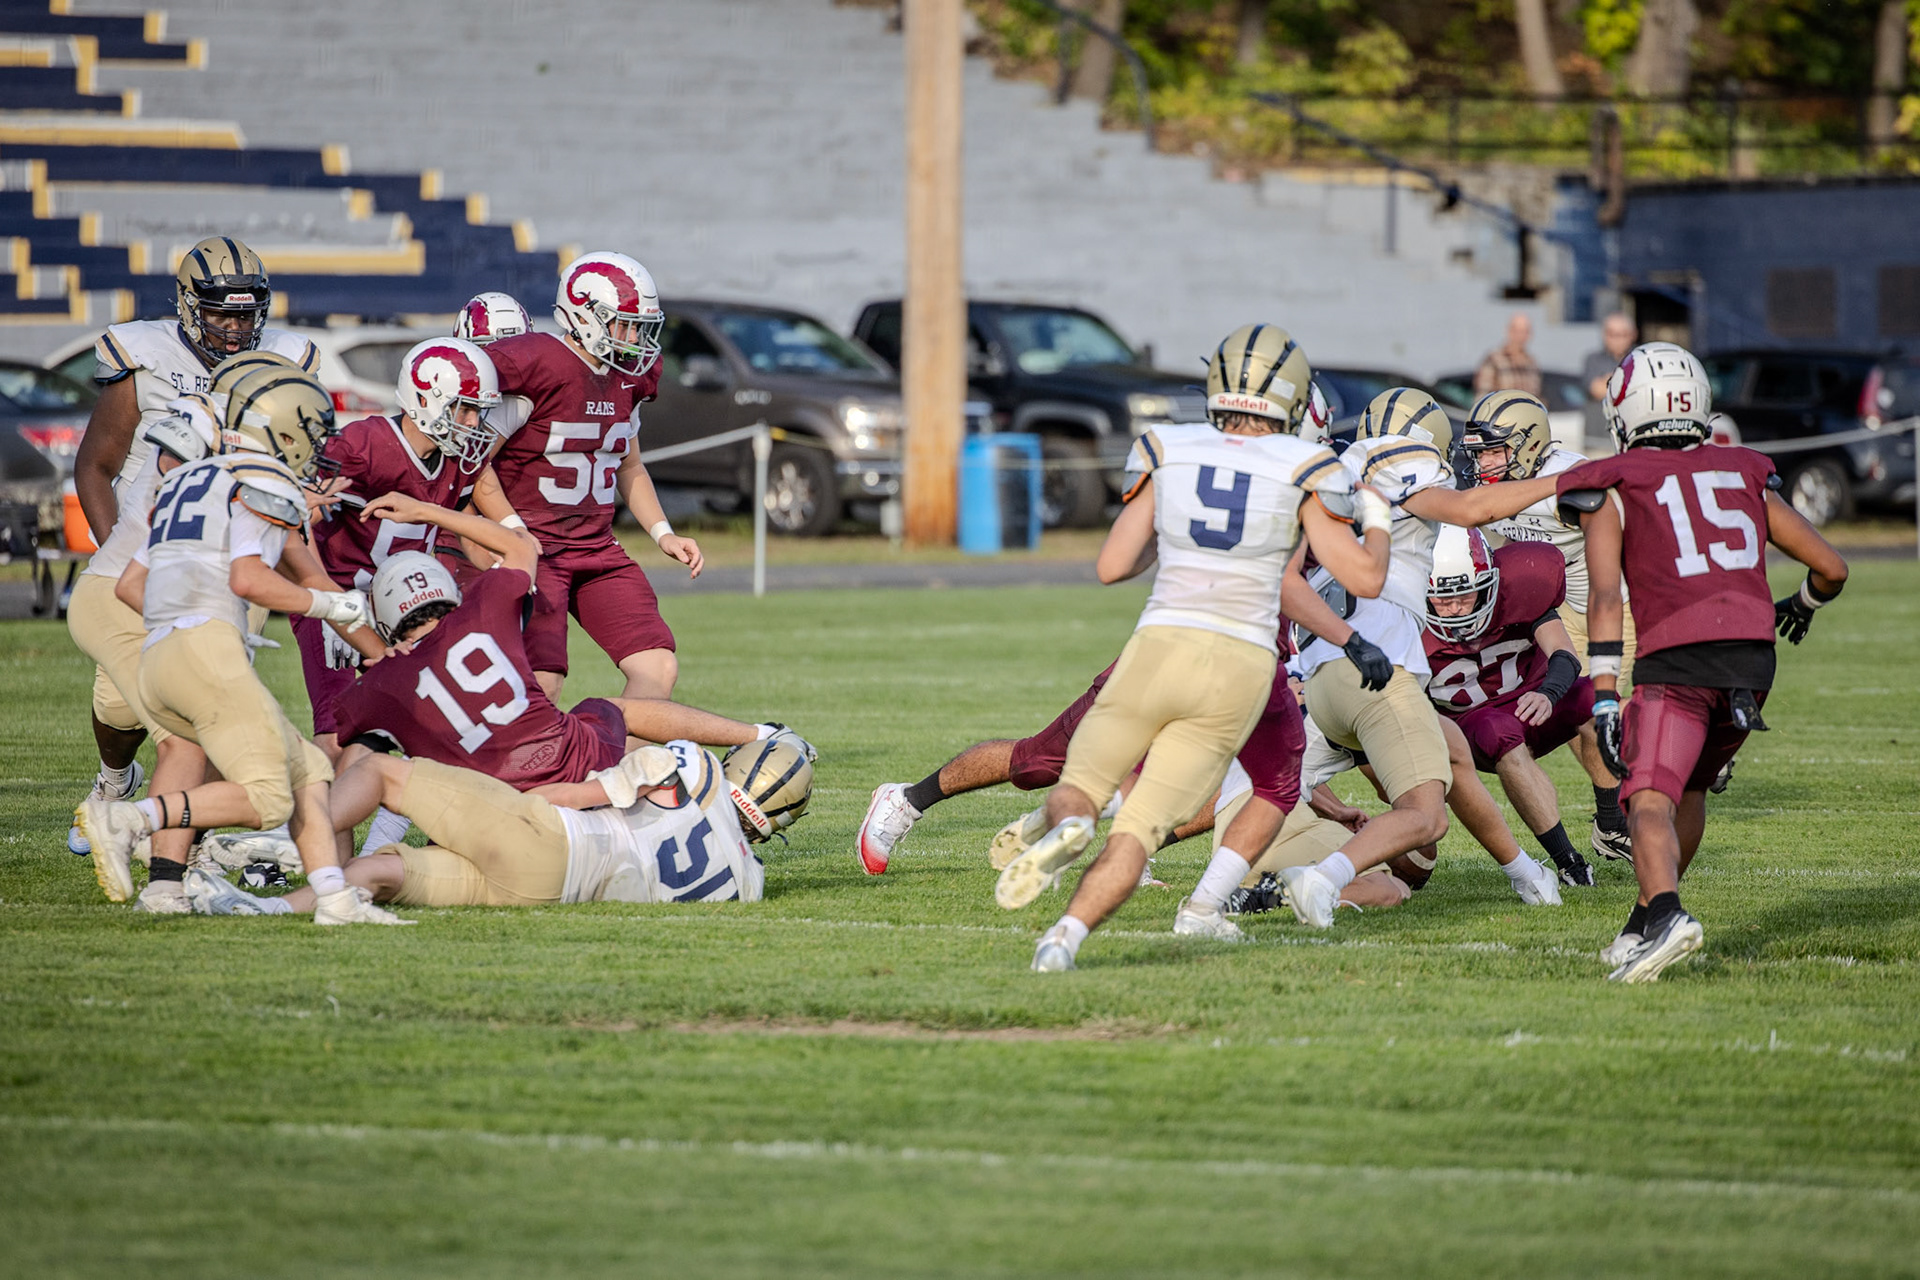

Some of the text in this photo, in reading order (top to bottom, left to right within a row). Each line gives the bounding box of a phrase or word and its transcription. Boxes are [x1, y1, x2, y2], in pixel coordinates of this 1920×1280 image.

[171, 372, 190, 390] ST.
[1218, 396, 1269, 412] Riddell
[1666, 391, 1692, 413] 15
[538, 421, 632, 506] 58
[148, 464, 221, 550] 22
[1189, 465, 1252, 551] 9
[1655, 470, 1760, 578] 15
[398, 588, 445, 614] Riddell
[403, 571, 429, 593] 19
[415, 631, 530, 755] 19
[1429, 638, 1533, 713] 87
[730, 788, 769, 829] Riddell
